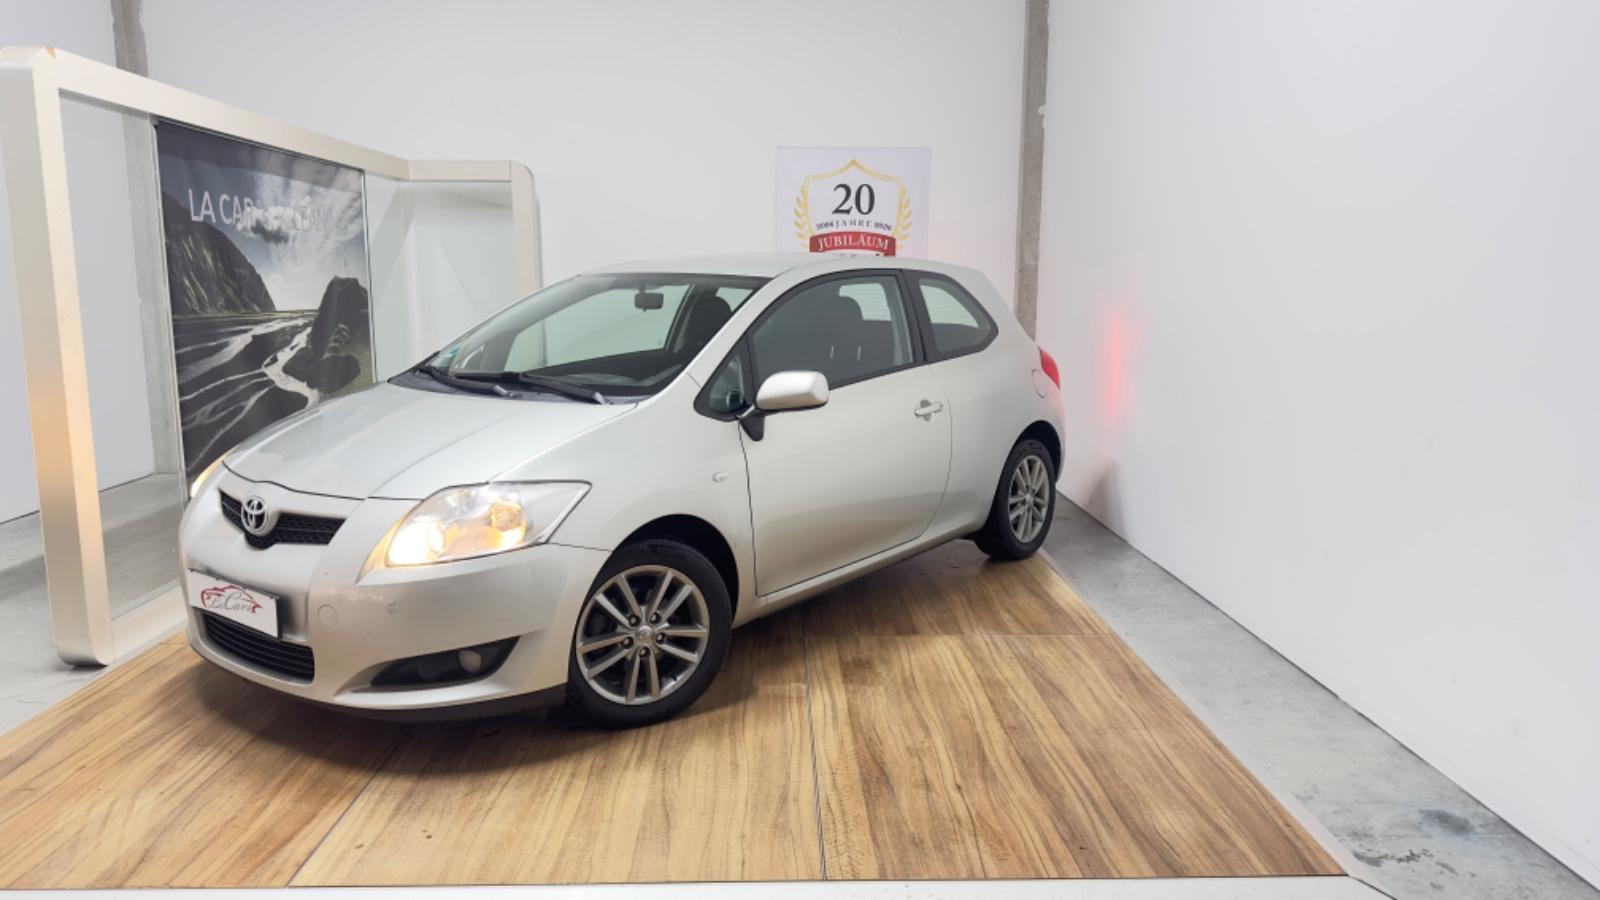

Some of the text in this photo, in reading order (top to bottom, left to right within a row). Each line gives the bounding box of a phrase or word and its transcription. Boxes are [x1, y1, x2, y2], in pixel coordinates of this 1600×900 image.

[187, 188, 217, 223] LA
[832, 183, 876, 216] 20
[836, 219, 872, 230] JAHRE
[818, 233, 890, 251] JUBILÄUM
